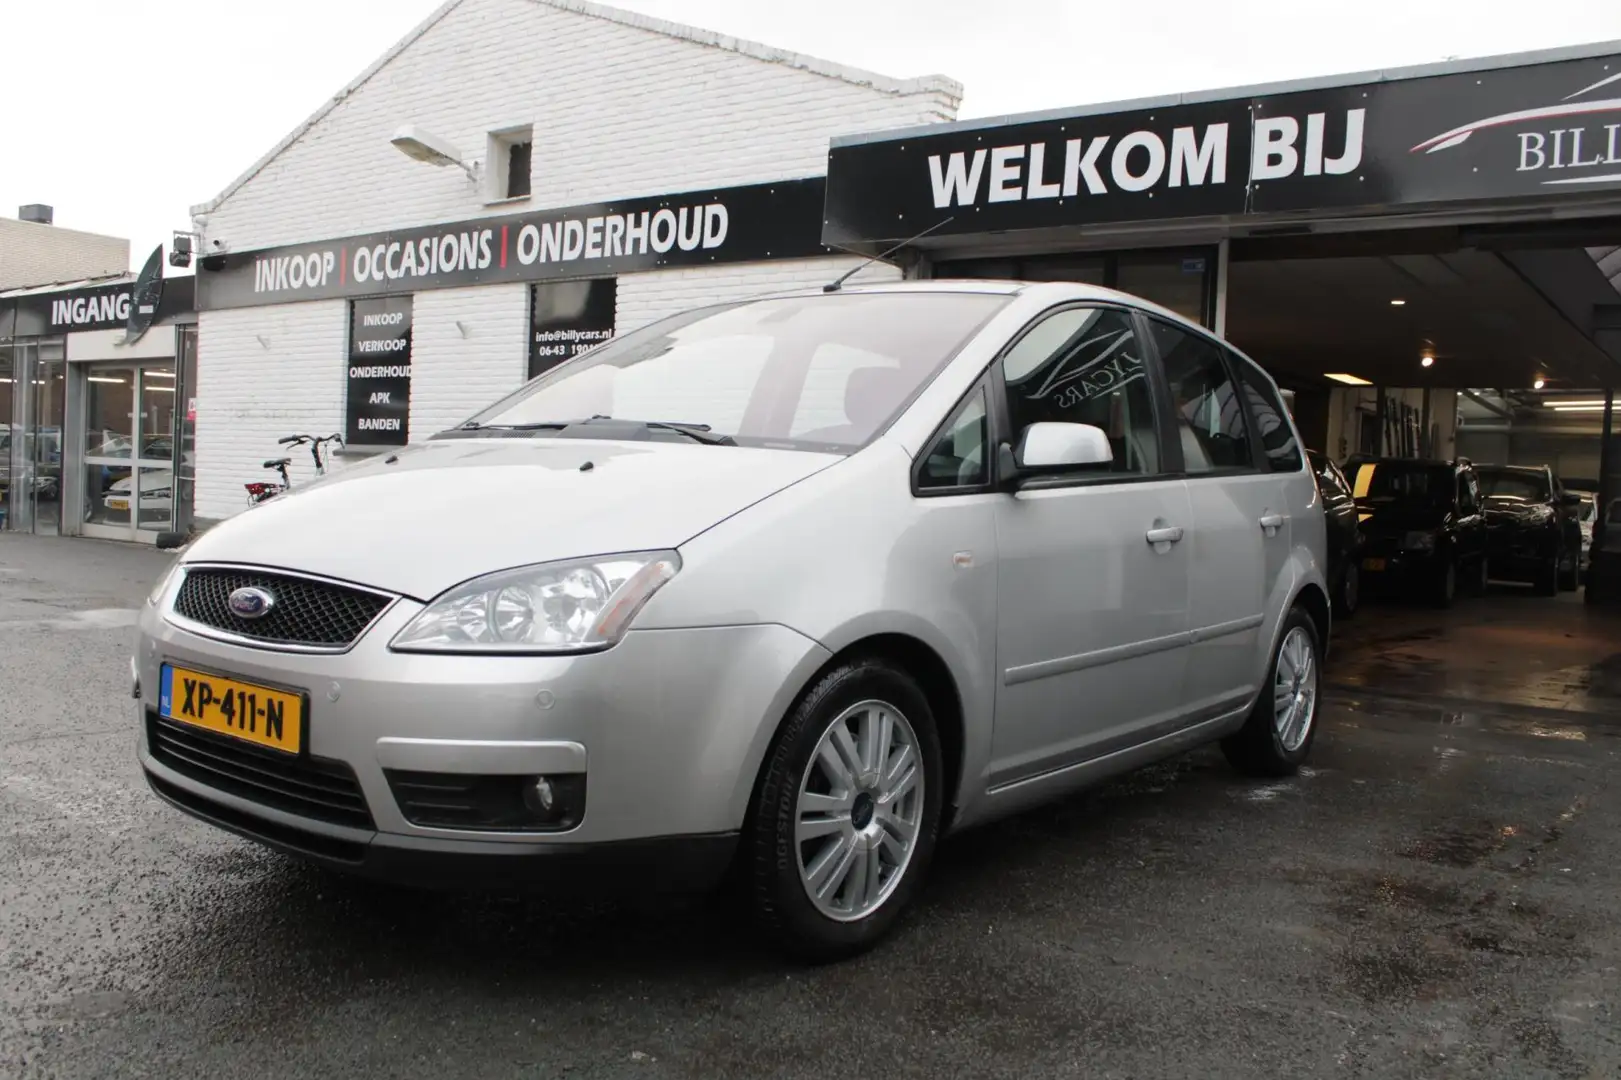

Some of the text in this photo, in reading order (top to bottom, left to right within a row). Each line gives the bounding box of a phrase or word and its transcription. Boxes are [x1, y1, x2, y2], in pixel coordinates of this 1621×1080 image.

[928, 108, 1366, 209] WELKOM BIJ
[254, 203, 729, 293] INKOOP OCCASIONS ONDERHOUD
[52, 293, 130, 325] INGANG
[364, 313, 403, 326] INKOOP
[536, 329, 611, 343] info@billycars.nl
[358, 339, 406, 352] VERKOOP
[540, 345, 564, 356] 06-43
[349, 365, 411, 378] ONDERHOUD
[369, 392, 390, 404] APK
[358, 418, 400, 431] BANDEN
[181, 678, 284, 740] XP-411-N
